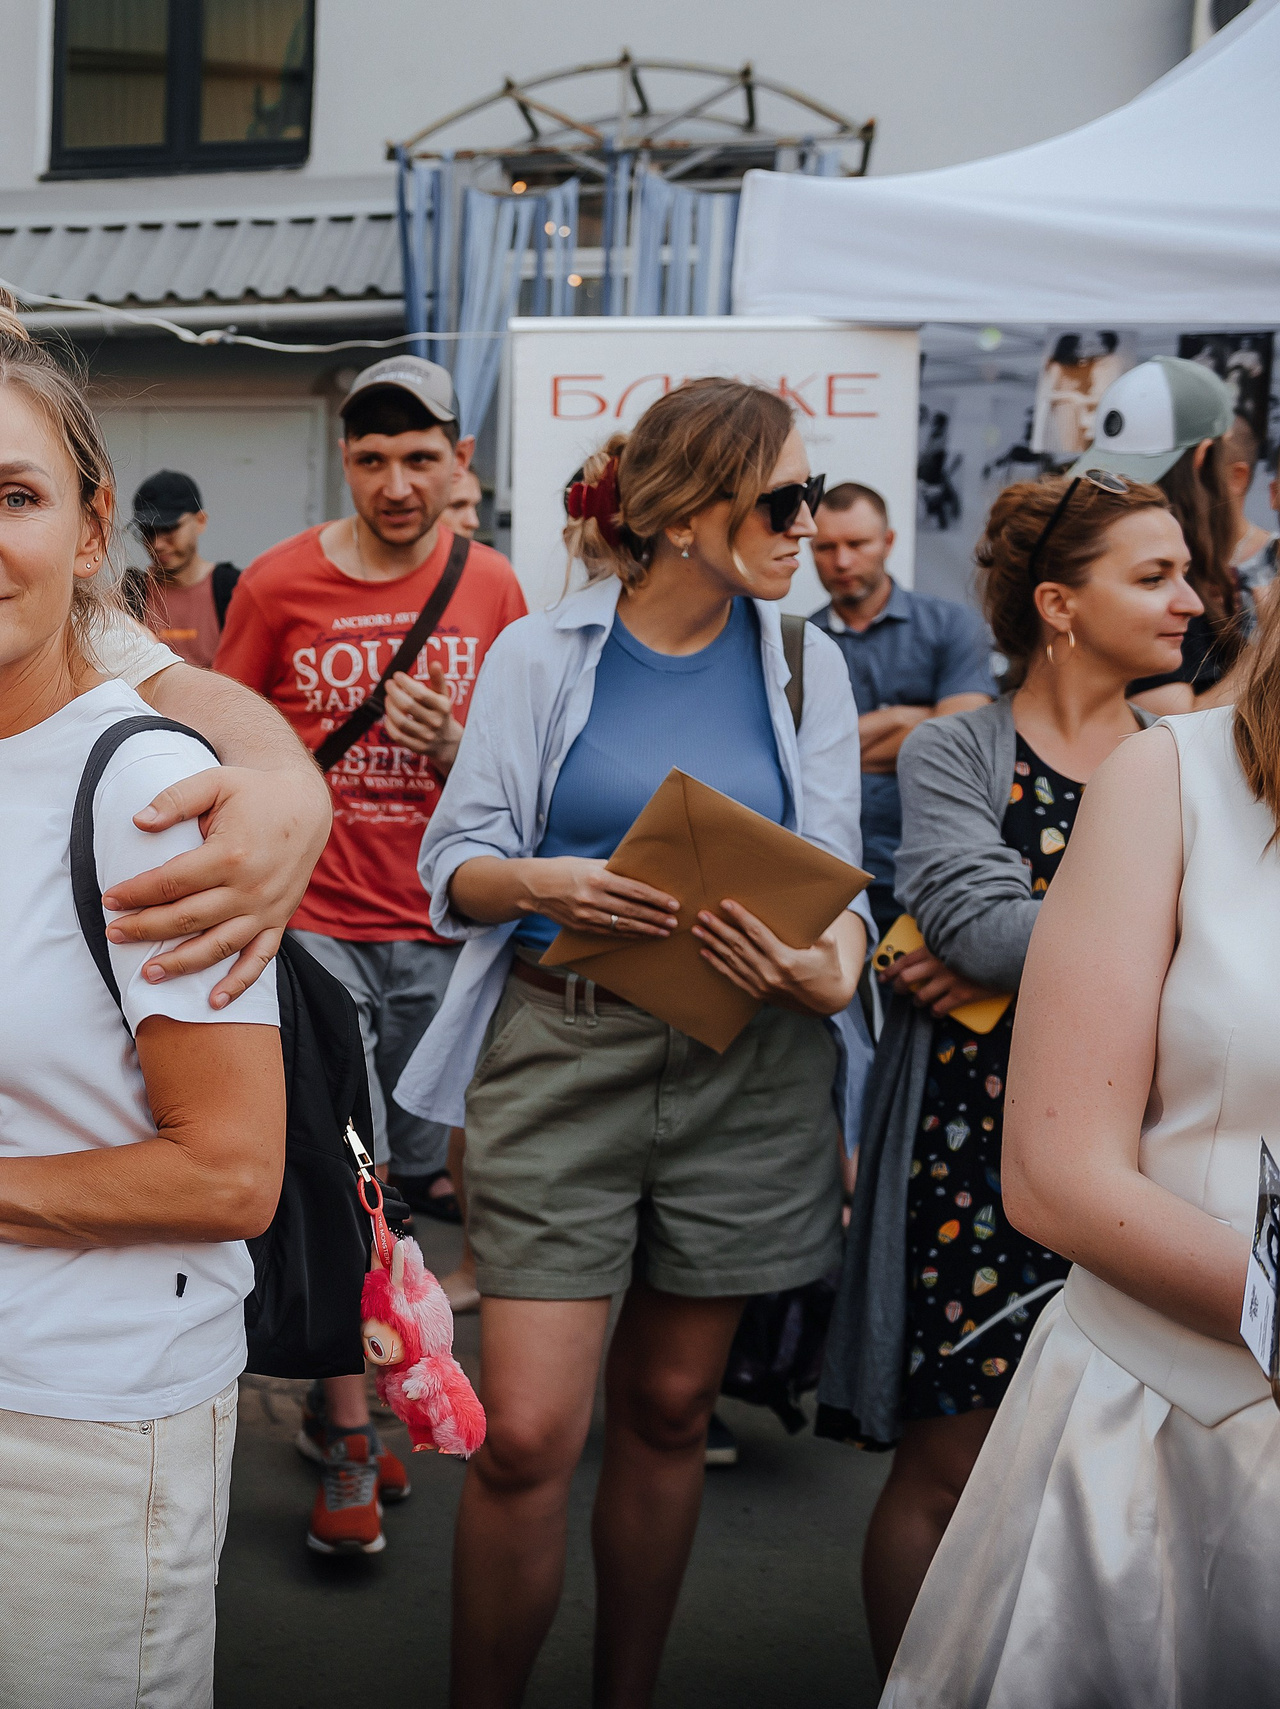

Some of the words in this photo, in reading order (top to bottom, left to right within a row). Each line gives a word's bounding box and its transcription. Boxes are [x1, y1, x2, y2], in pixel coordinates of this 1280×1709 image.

[551, 373, 880, 421] БЛЖЕ
[332, 613, 392, 631] ANCHORS
[380, 1229, 390, 1265] MONSTERS
